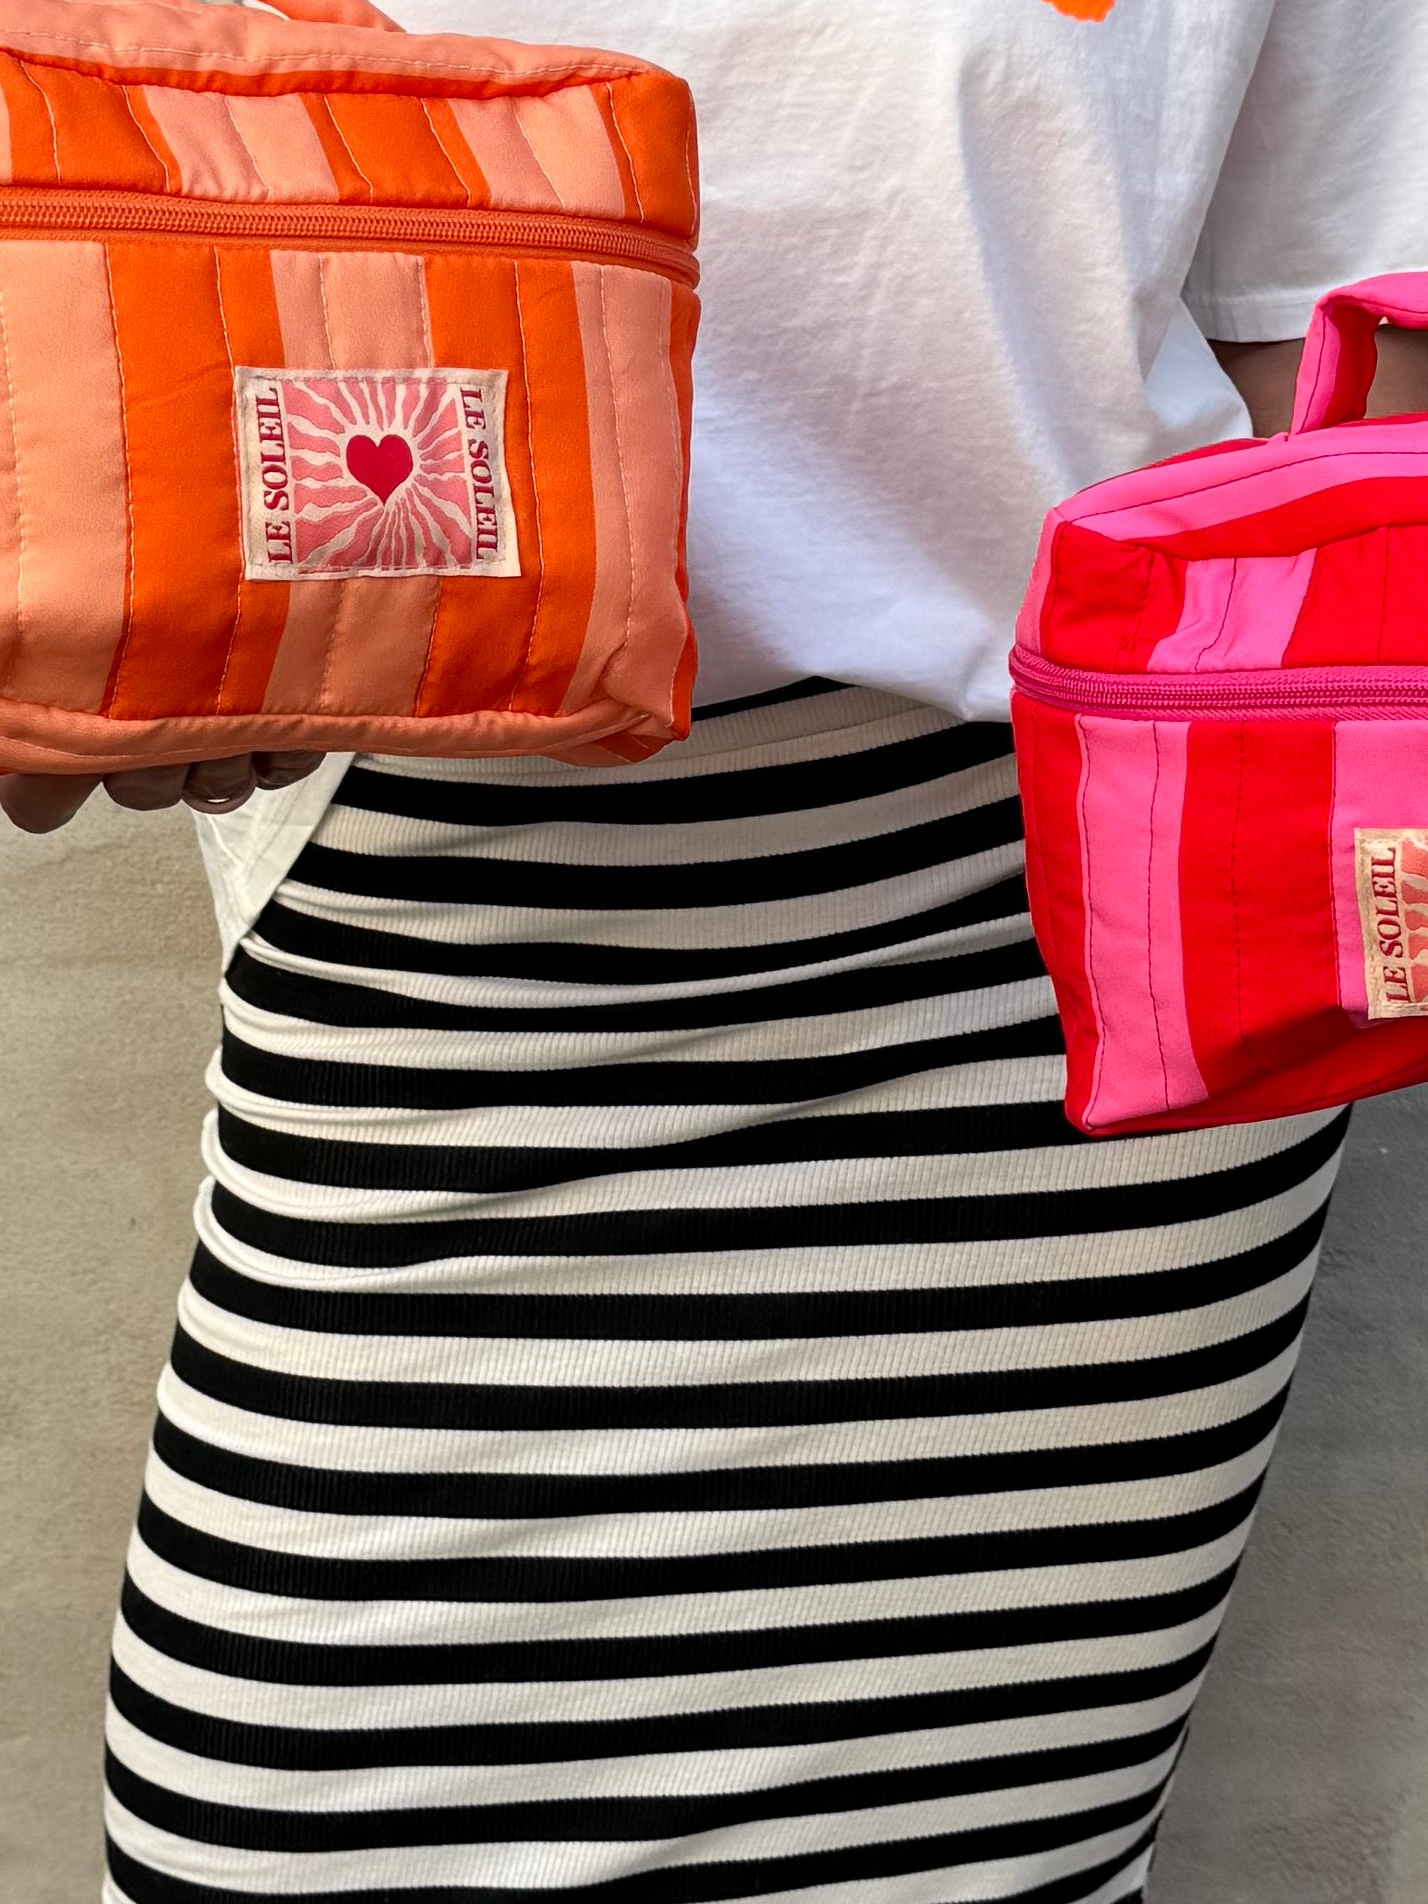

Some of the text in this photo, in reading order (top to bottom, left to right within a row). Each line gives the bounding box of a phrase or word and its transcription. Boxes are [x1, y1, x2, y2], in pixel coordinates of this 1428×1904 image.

[256, 387, 293, 564] LE SOLEIL
[460, 387, 499, 561] LE SOLEIL
[1371, 847, 1412, 1004] LE SOLEIL
